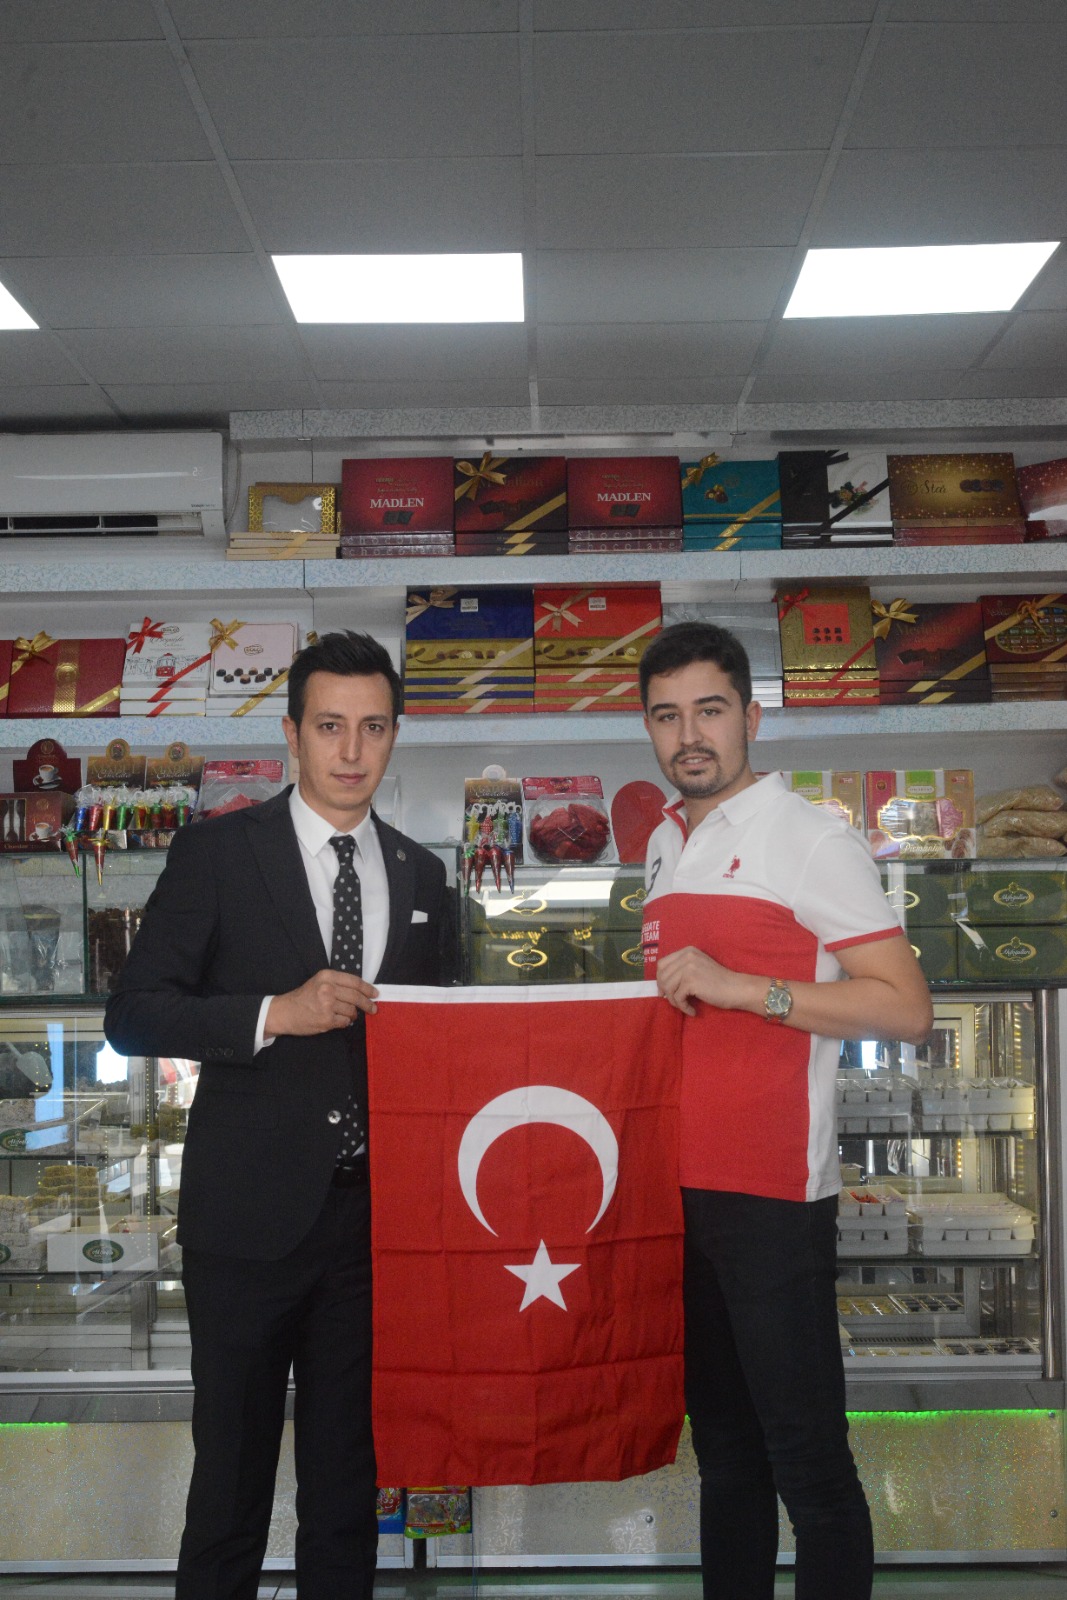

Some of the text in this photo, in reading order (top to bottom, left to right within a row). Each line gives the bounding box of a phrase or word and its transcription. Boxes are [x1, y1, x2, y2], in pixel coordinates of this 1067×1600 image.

[920, 479, 946, 494] Star
[597, 492, 651, 502] MADLEN
[370, 498, 424, 508] MADLEN
